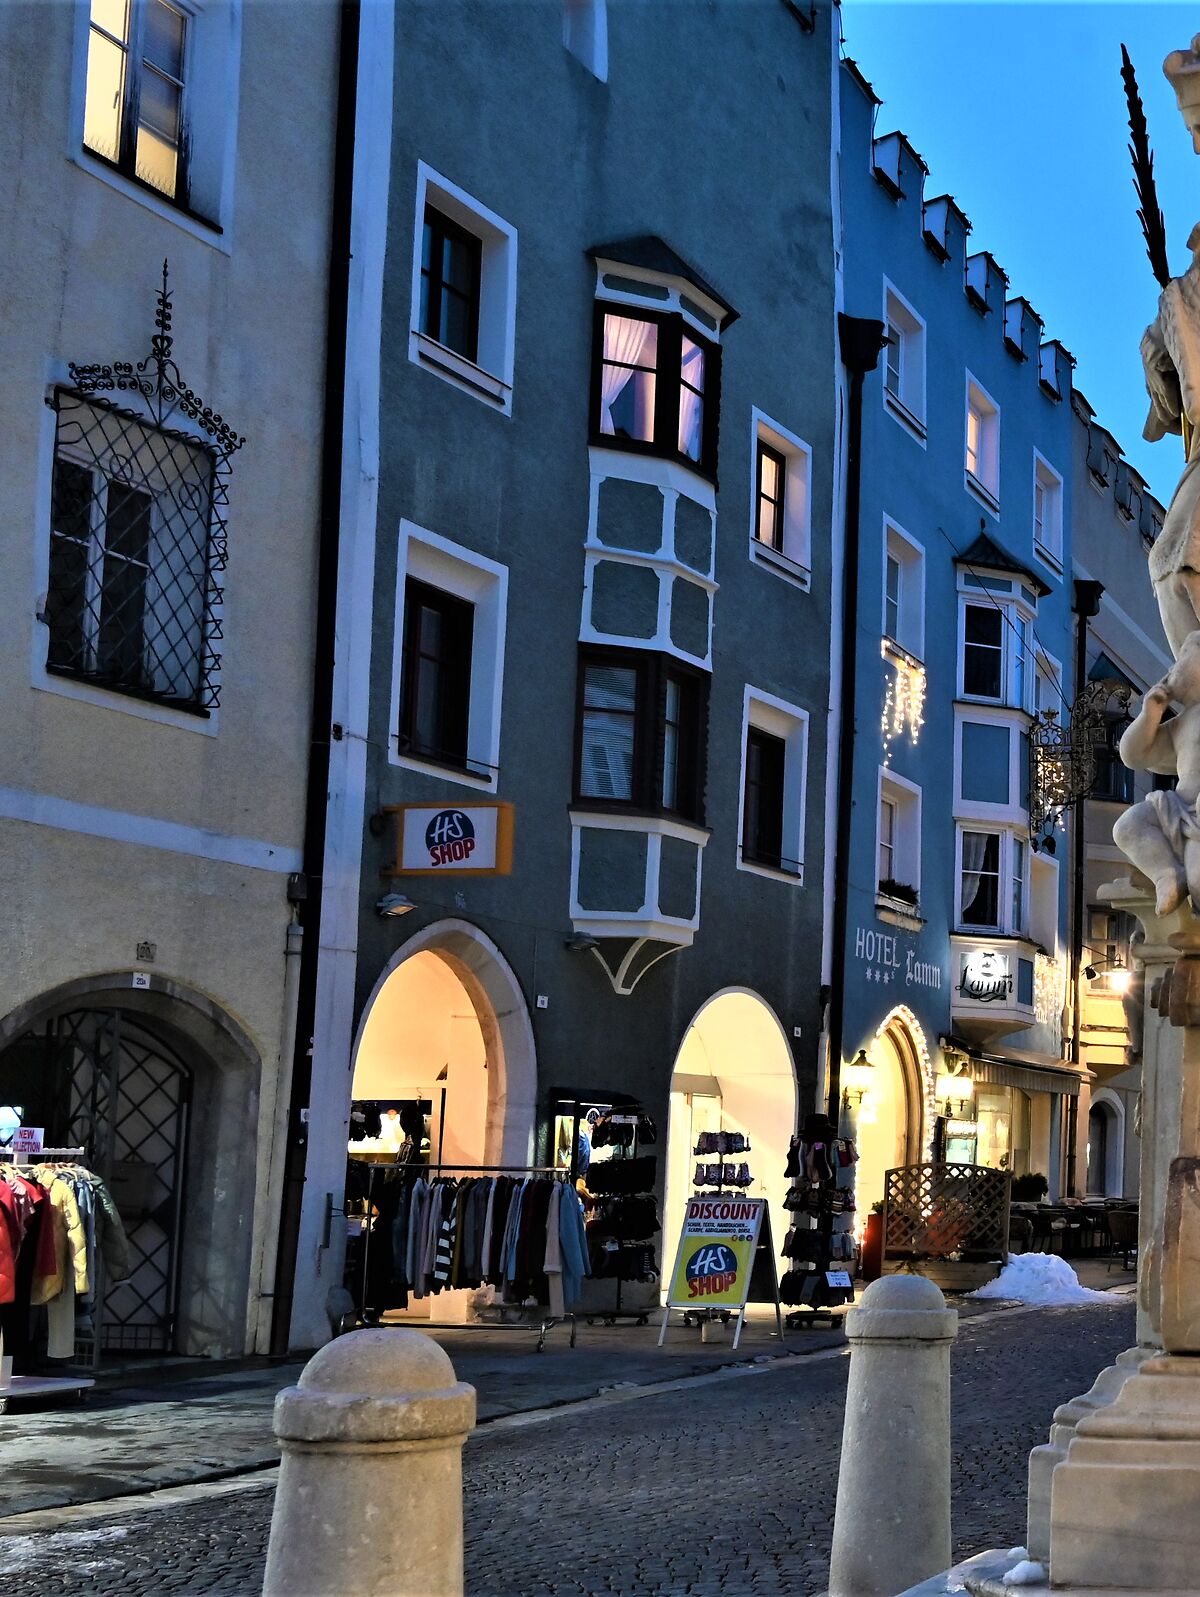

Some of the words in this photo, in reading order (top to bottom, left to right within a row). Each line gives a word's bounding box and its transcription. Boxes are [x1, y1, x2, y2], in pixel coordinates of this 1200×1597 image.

[429, 812, 464, 843] HS
[430, 838, 475, 868] SHOP
[855, 927, 901, 968] HOTEL
[905, 949, 942, 990] Lamm
[954, 964, 1014, 1002] Lamm
[19, 1129, 35, 1140] NEW
[688, 1202, 760, 1221] DISCOUNT
[690, 1246, 728, 1275] HS
[687, 1271, 737, 1299] SHOP
